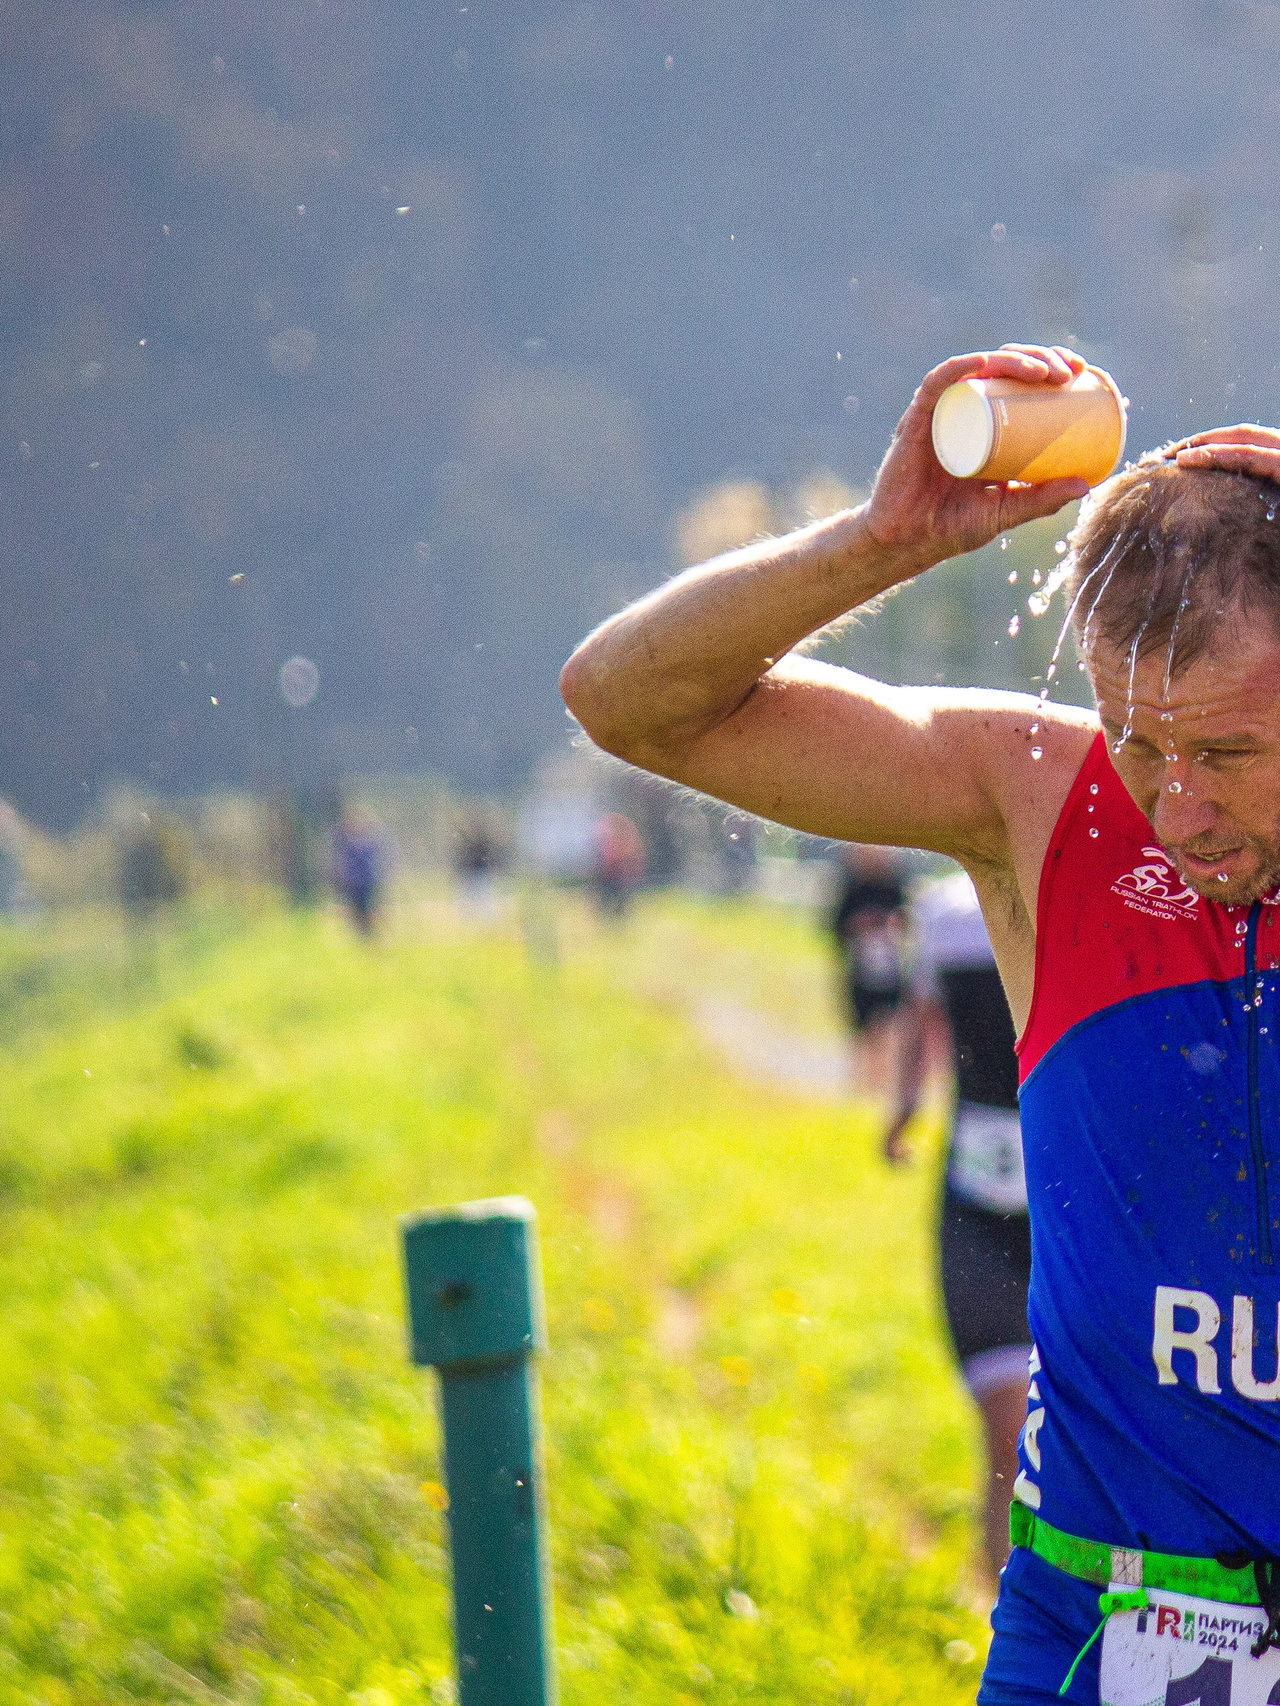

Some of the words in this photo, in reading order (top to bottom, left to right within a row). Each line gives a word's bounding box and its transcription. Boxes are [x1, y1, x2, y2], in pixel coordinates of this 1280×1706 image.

[1110, 885, 1148, 904] RUSSIAN
[1151, 900, 1198, 921] TRIATHLON
[1124, 899, 1177, 921] FEDERATION
[1198, 1630, 1239, 1651] 2024
